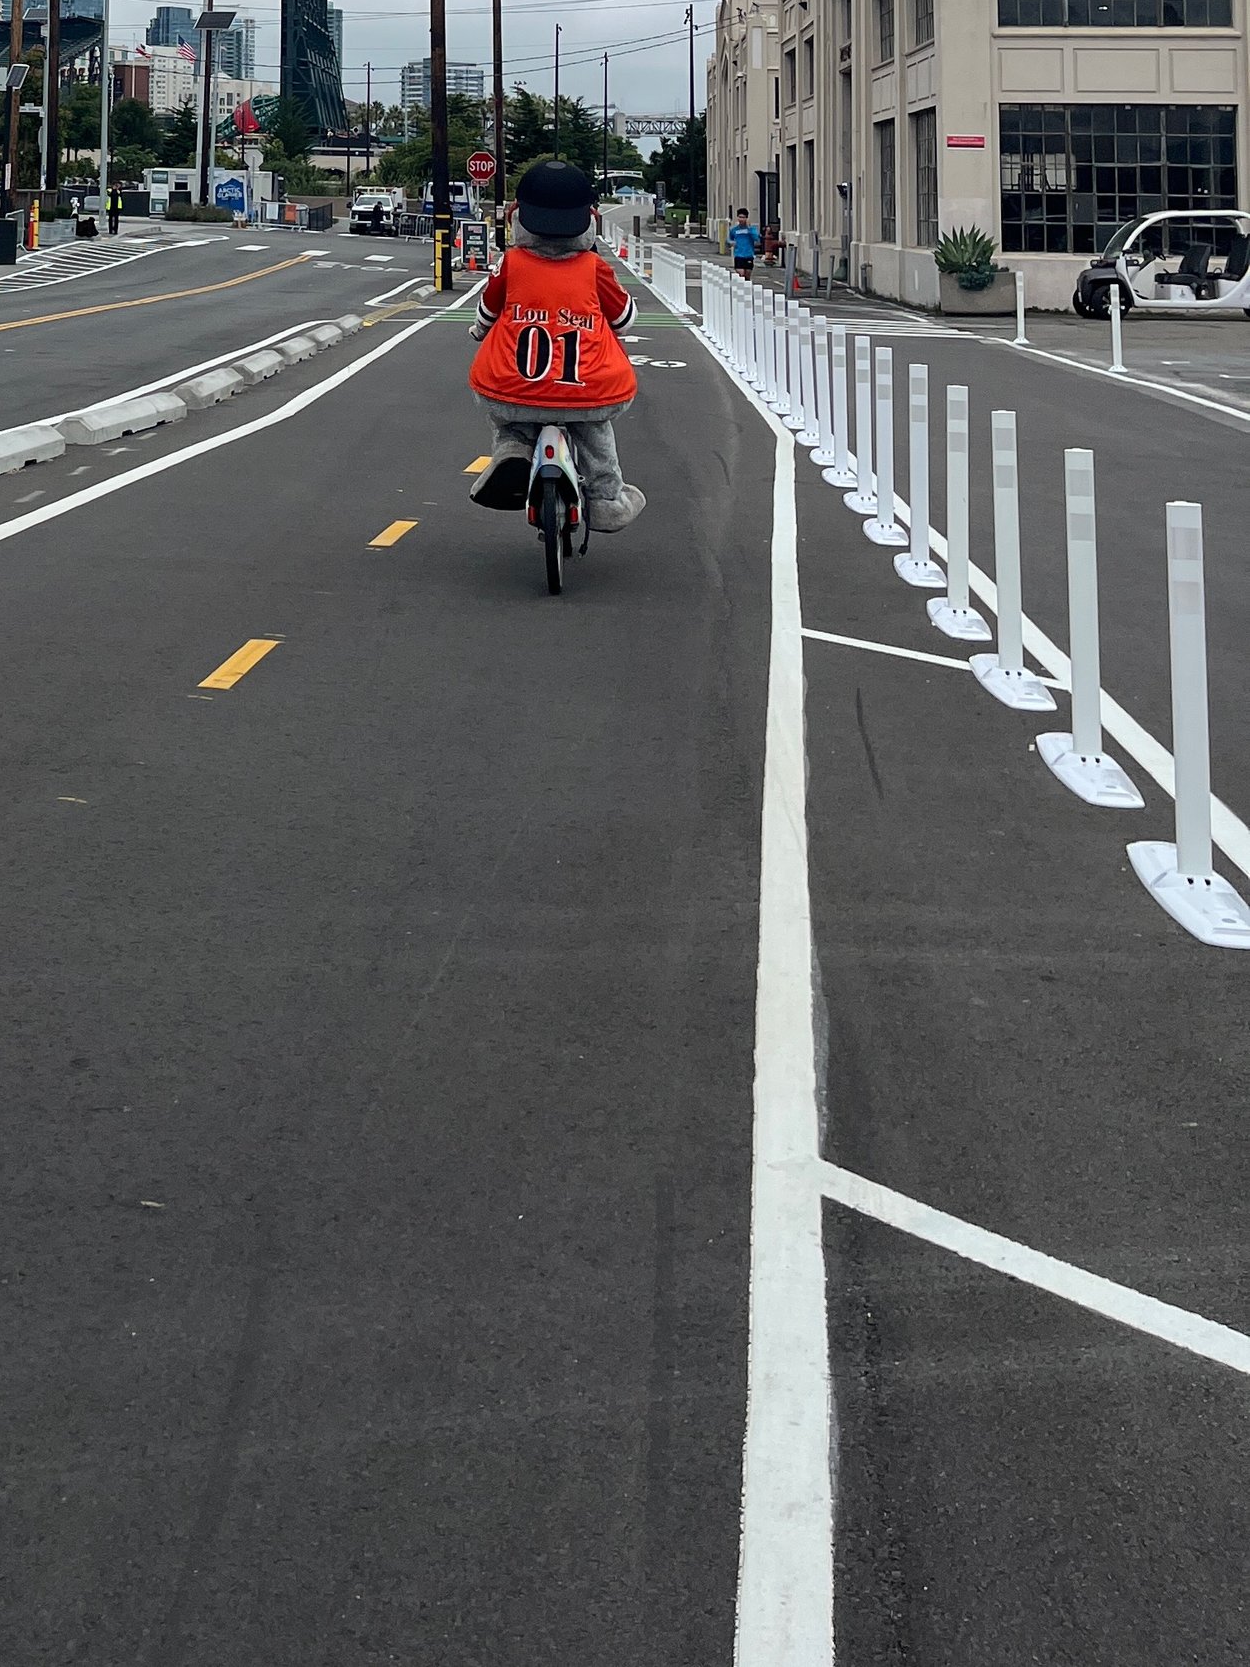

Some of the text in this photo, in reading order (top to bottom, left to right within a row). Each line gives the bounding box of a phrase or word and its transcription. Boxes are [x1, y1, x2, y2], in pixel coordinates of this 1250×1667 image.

[469, 160, 494, 172] STOP
[512, 304, 594, 331] Lou Seal
[516, 324, 587, 387] 01
